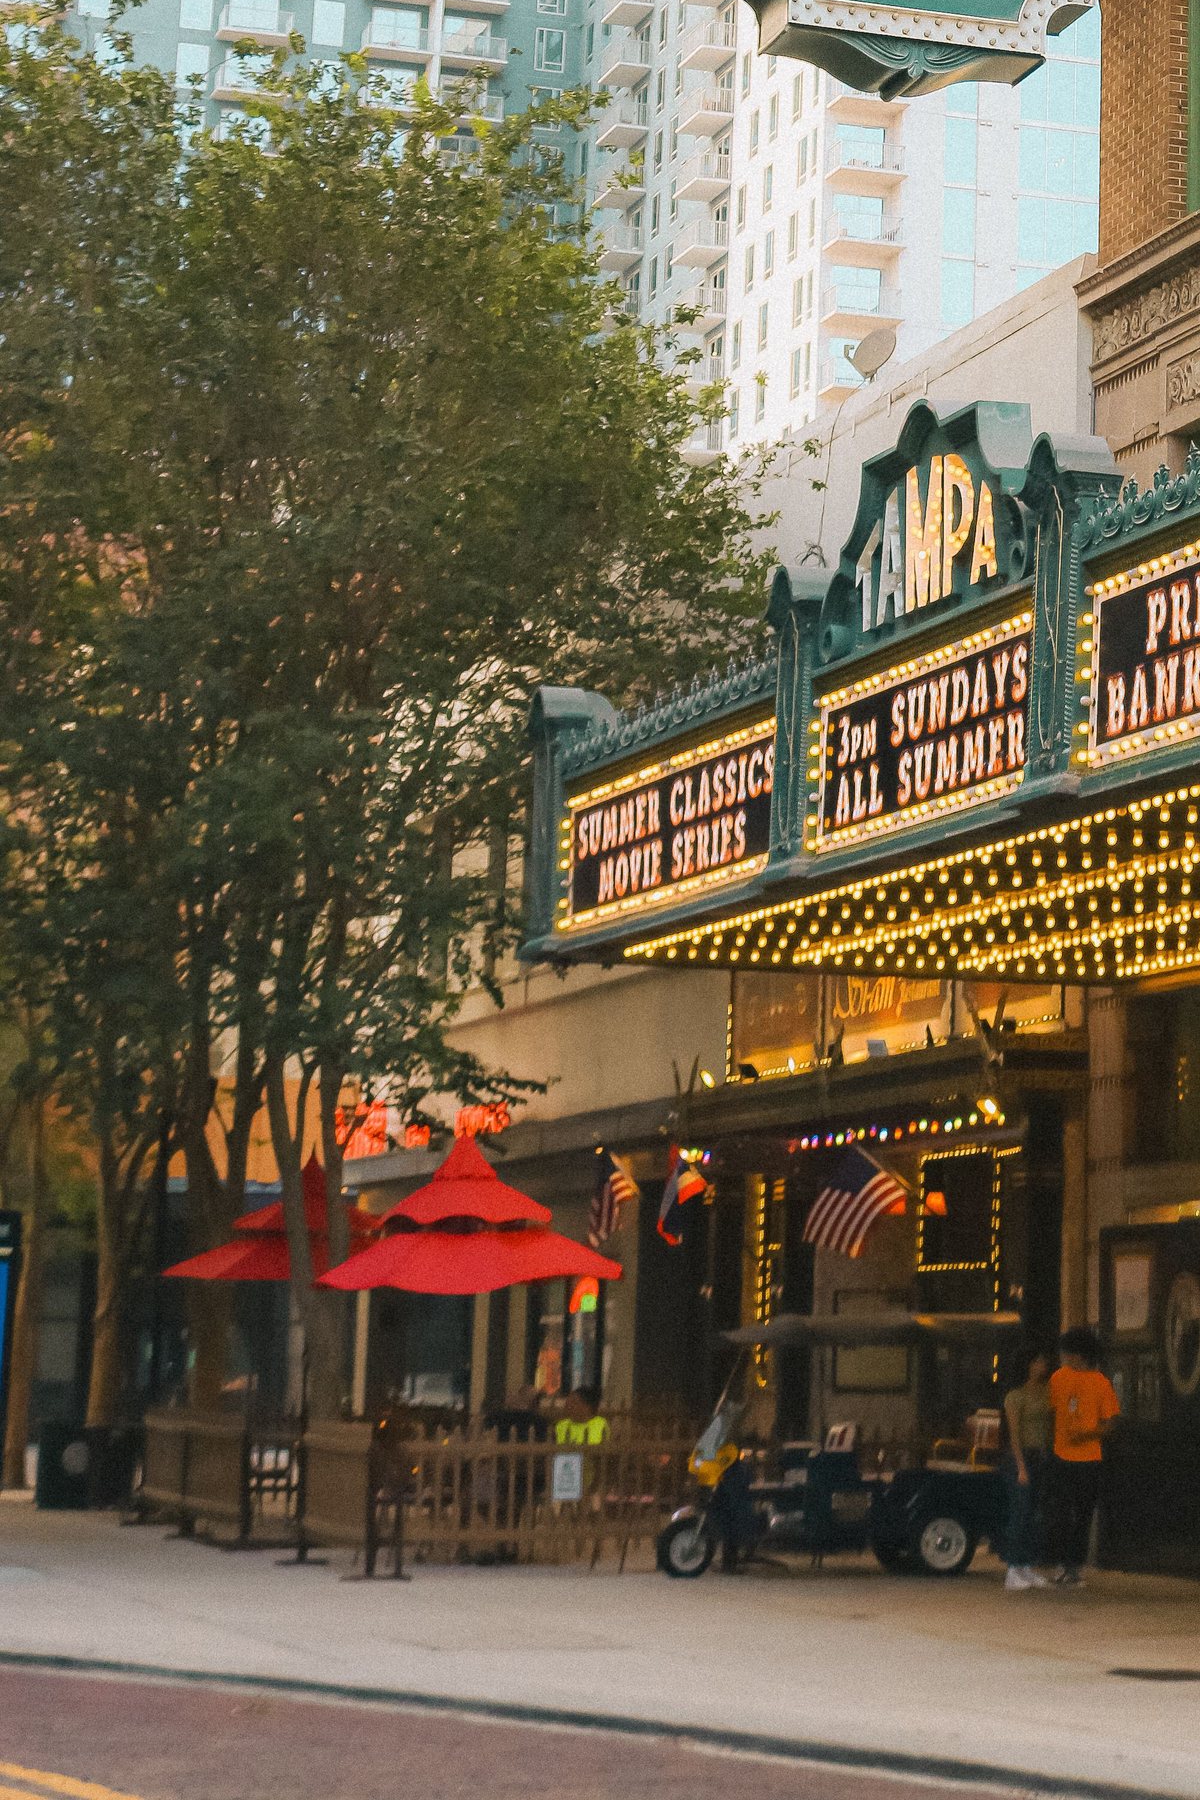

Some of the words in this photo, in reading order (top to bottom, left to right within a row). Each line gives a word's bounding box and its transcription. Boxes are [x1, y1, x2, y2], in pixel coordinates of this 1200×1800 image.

[855, 453, 998, 633] TAMPA
[837, 713, 877, 768] 3PM
[890, 640, 1028, 748] SUNDAYS
[578, 788, 661, 861] SUMMER
[669, 743, 776, 827] CLASSICS
[834, 762, 884, 827] ALL
[897, 708, 1026, 807] SUMMER
[597, 837, 663, 904] MOVIE
[671, 808, 747, 880] SERIES
